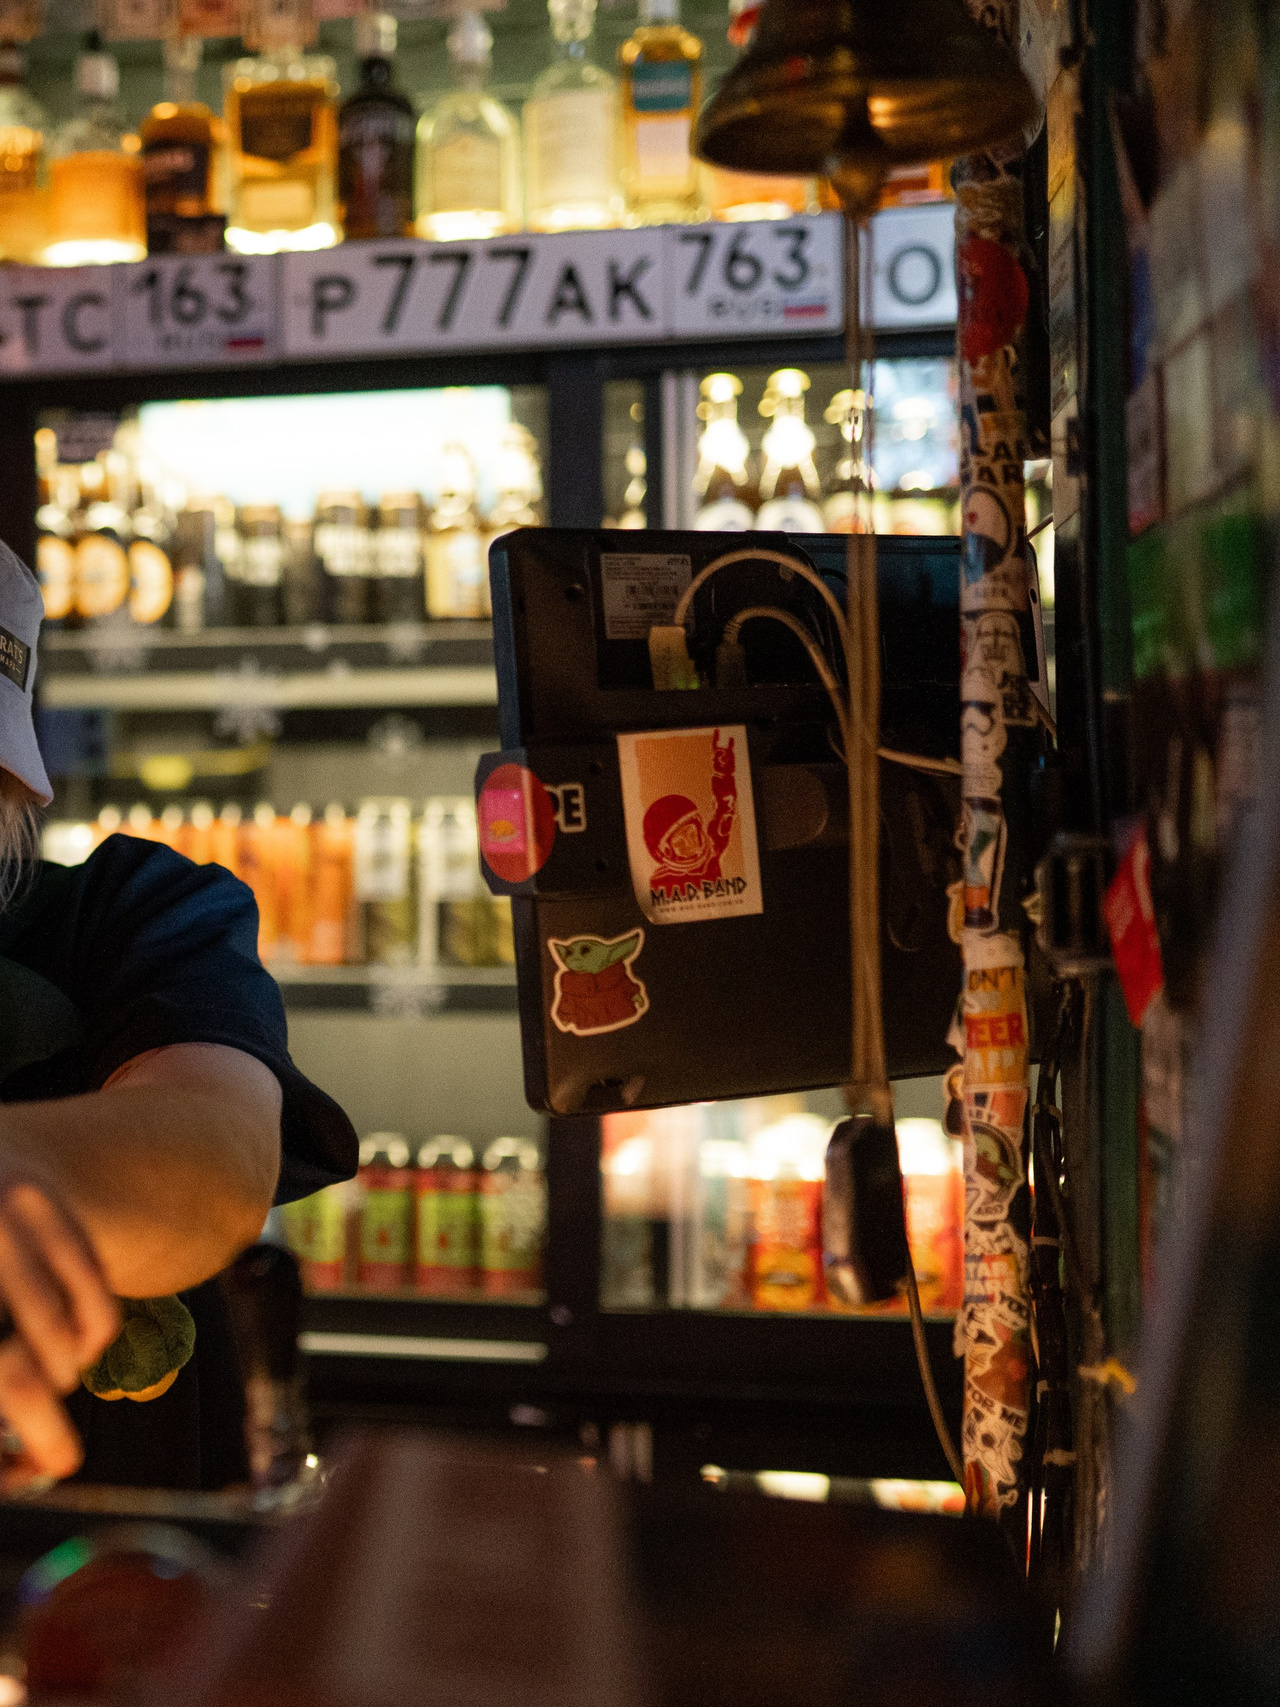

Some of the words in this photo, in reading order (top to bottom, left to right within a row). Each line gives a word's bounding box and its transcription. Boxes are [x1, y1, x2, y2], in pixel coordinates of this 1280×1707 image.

[678, 226, 811, 297] 763
[131, 262, 252, 326] 163
[703, 876, 748, 899] BAND
